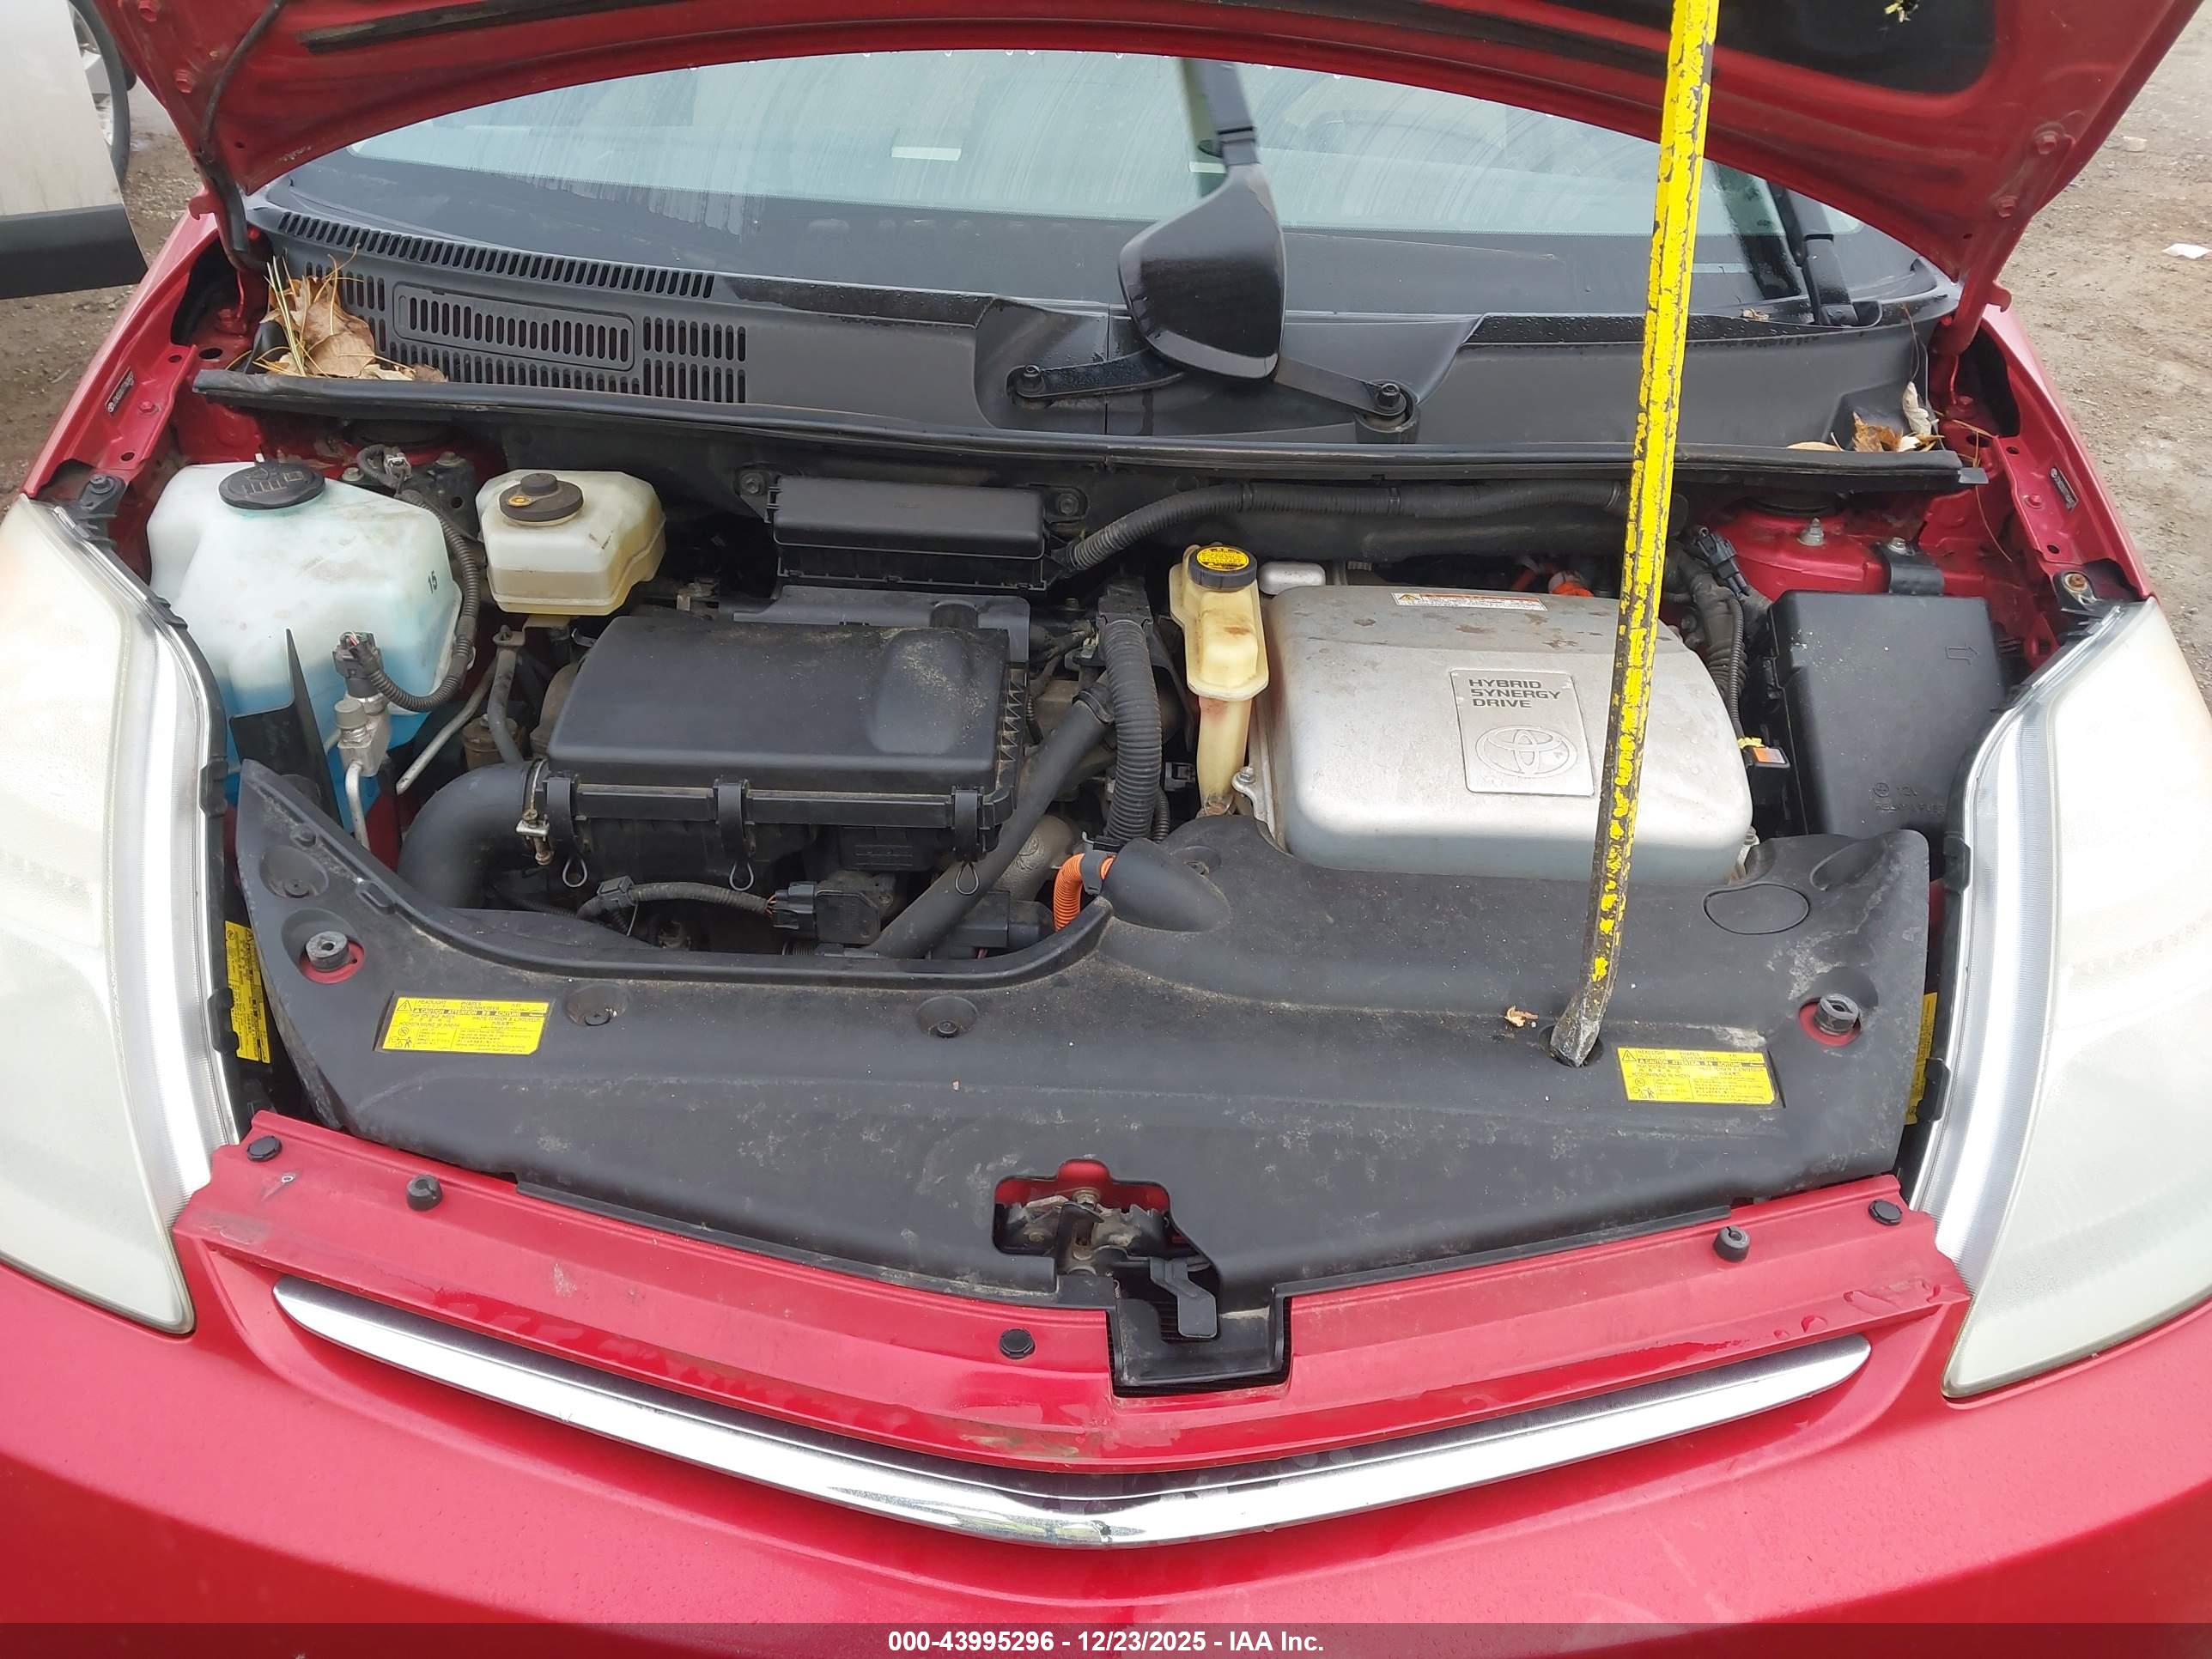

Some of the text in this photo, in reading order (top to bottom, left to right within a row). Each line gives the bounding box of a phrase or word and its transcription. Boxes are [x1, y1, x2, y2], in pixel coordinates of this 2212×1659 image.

[428, 570, 438, 594] 15
[1468, 679, 1541, 689] HYBRID
[1471, 689, 1561, 700] SYNERGY
[1473, 699, 1532, 708] DRIVE
